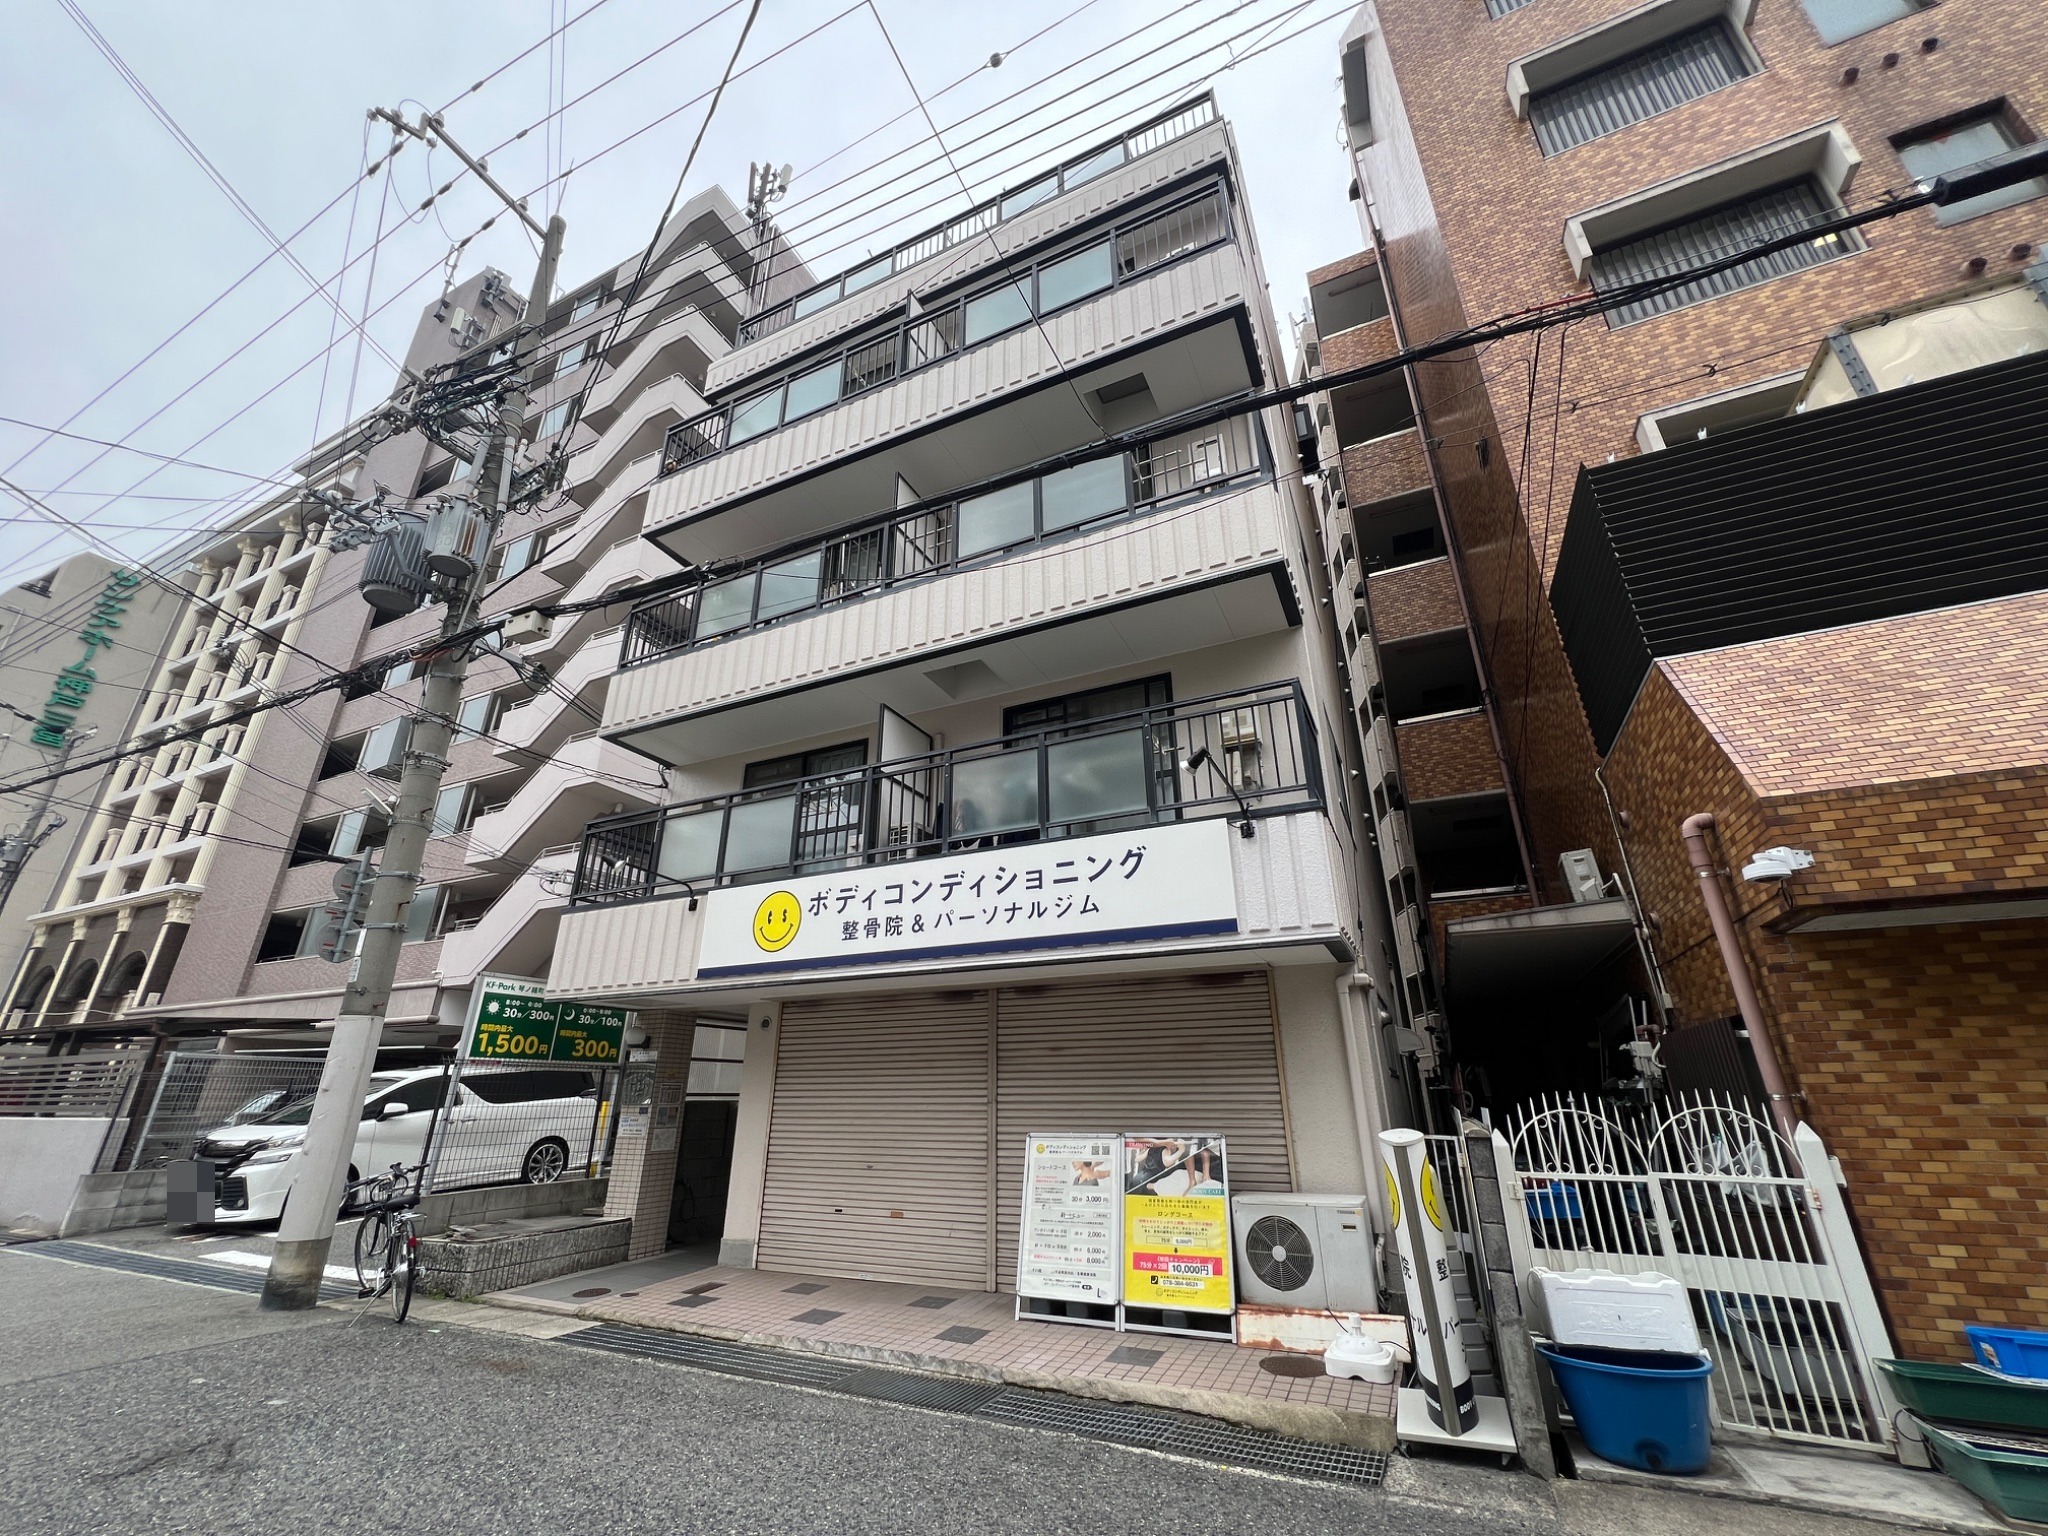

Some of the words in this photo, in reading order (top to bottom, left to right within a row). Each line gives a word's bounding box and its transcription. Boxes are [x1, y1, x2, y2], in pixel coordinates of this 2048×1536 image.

[808, 845, 1148, 917] ボディコンディショニング
[841, 913, 903, 942] 整骨院
[911, 914, 925, 934] &
[934, 894, 1100, 929] パーソナルジム
[485, 980, 516, 991] KF-Park
[478, 1032, 548, 1056] 1,500円
[572, 1039, 617, 1058] 300円
[1172, 1265, 1209, 1275] 10,000円
